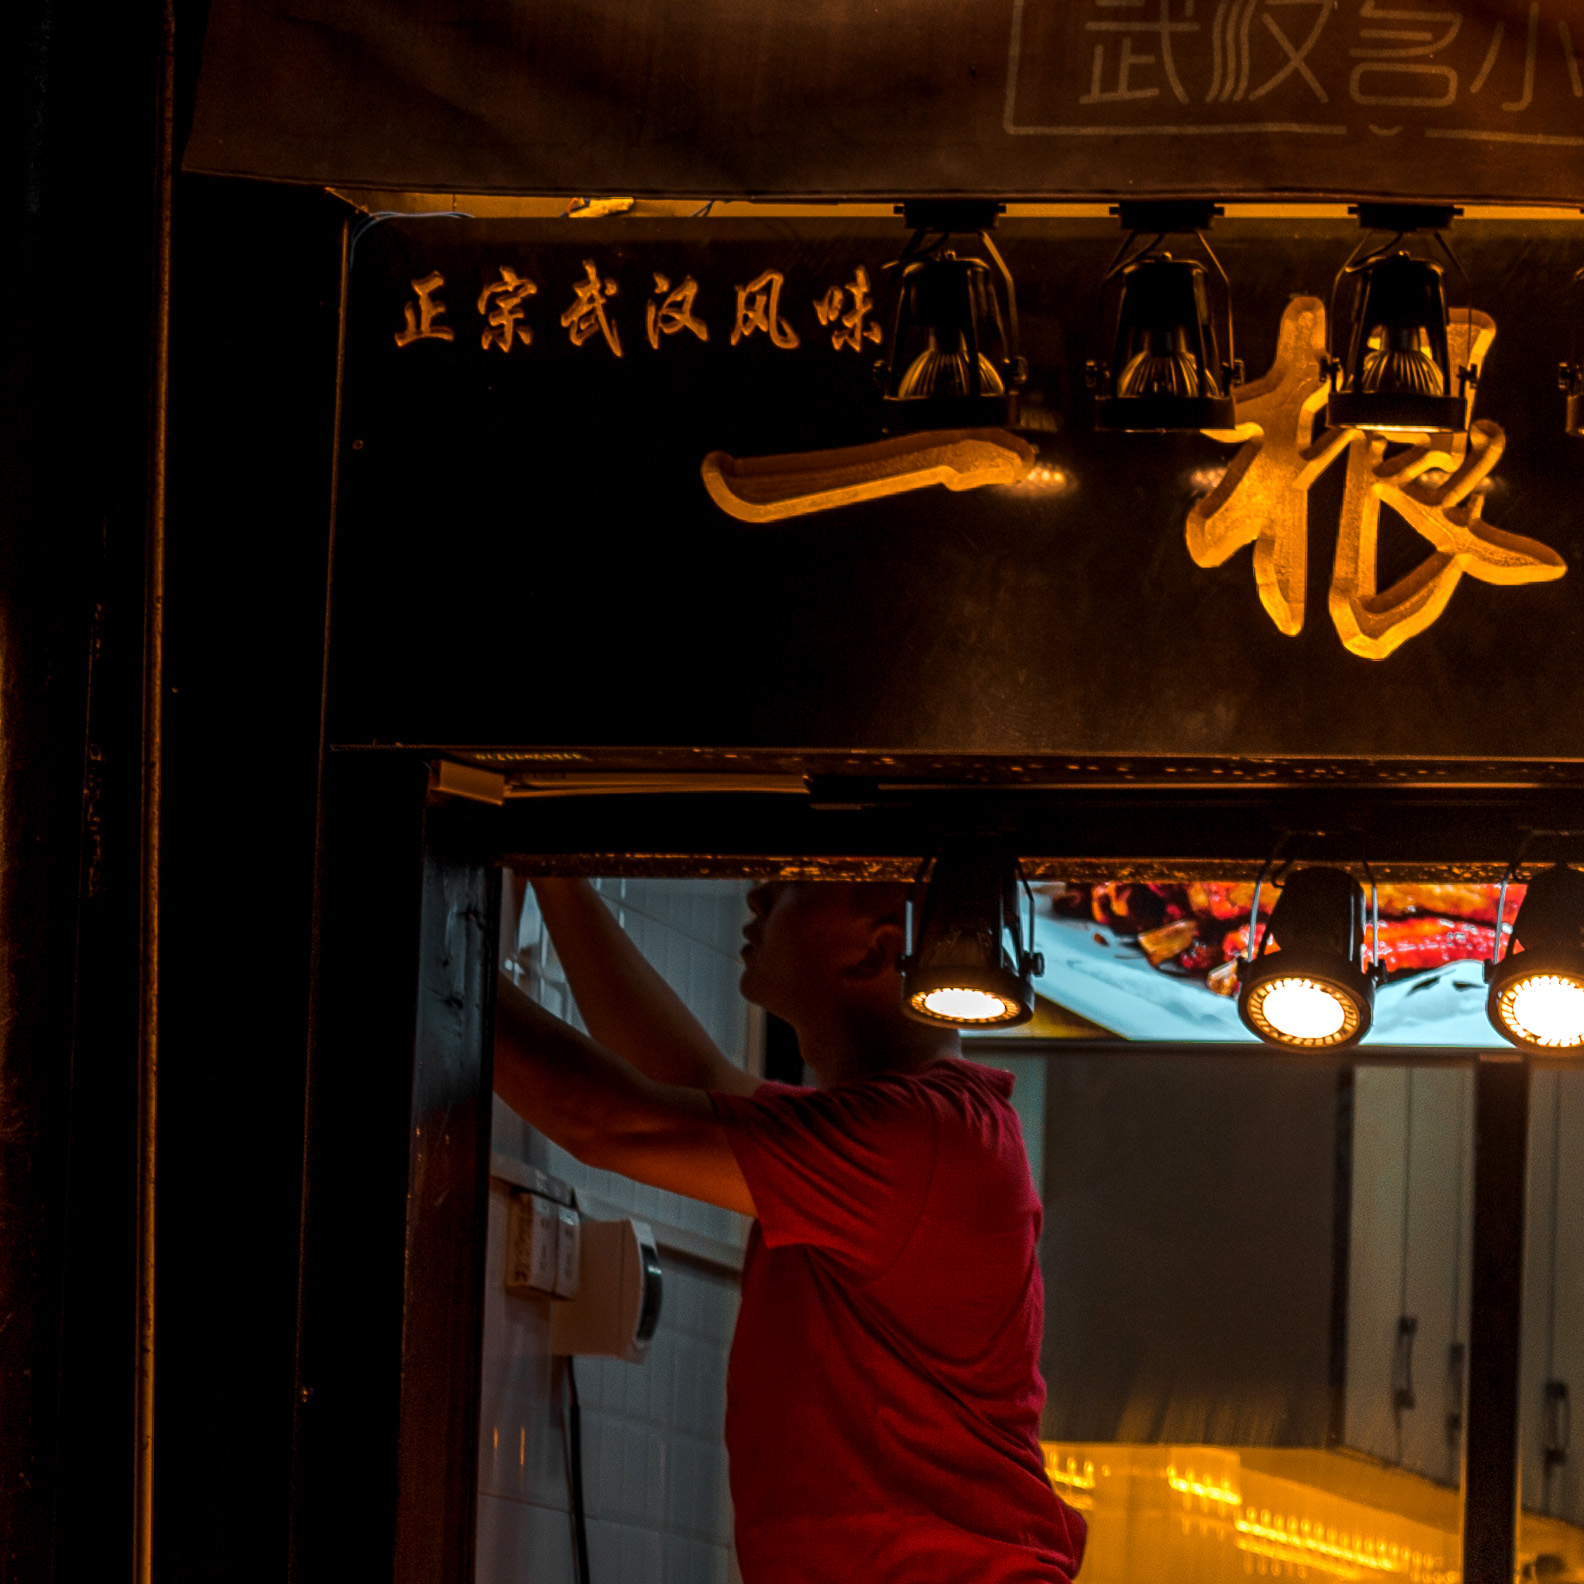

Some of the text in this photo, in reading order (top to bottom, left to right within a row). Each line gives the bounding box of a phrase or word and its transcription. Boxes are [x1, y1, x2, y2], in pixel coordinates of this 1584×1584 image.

[394, 258, 883, 358] 正宗武汉风味
